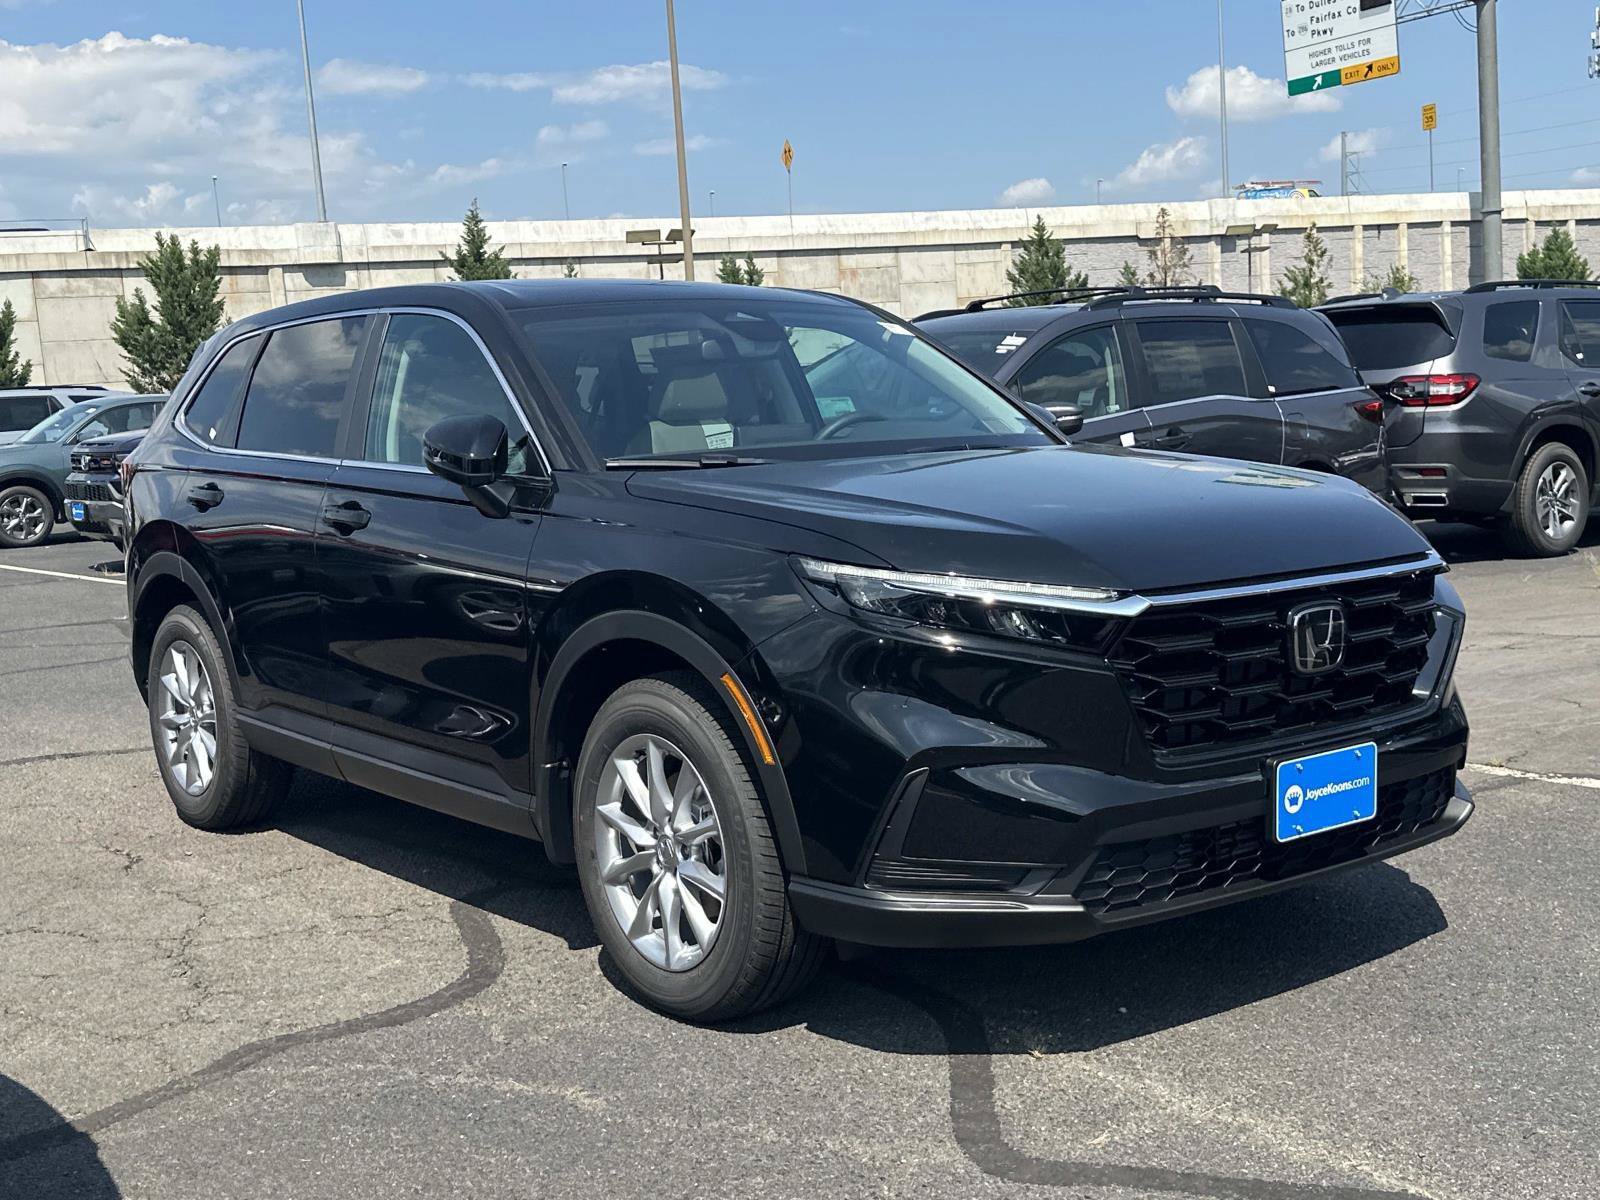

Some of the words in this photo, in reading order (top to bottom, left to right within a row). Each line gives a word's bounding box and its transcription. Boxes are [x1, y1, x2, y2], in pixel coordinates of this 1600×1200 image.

[1295, 4, 1305, 13] To
[1310, 10, 1342, 24] Fairfax
[1346, 6, 1357, 15] Co
[1286, 29, 1296, 38] To
[1311, 27, 1334, 38] Pkwy
[1308, 47, 1332, 59] HIGHER
[1335, 41, 1355, 53] TOLLS
[1358, 37, 1372, 47] FOR
[1310, 56, 1336, 69] LARGER
[1338, 49, 1371, 62] VEHICLES
[1344, 70, 1360, 80] EXIT
[1377, 62, 1395, 72] ONLY
[1305, 777, 1370, 801] JoyceKoons.com
